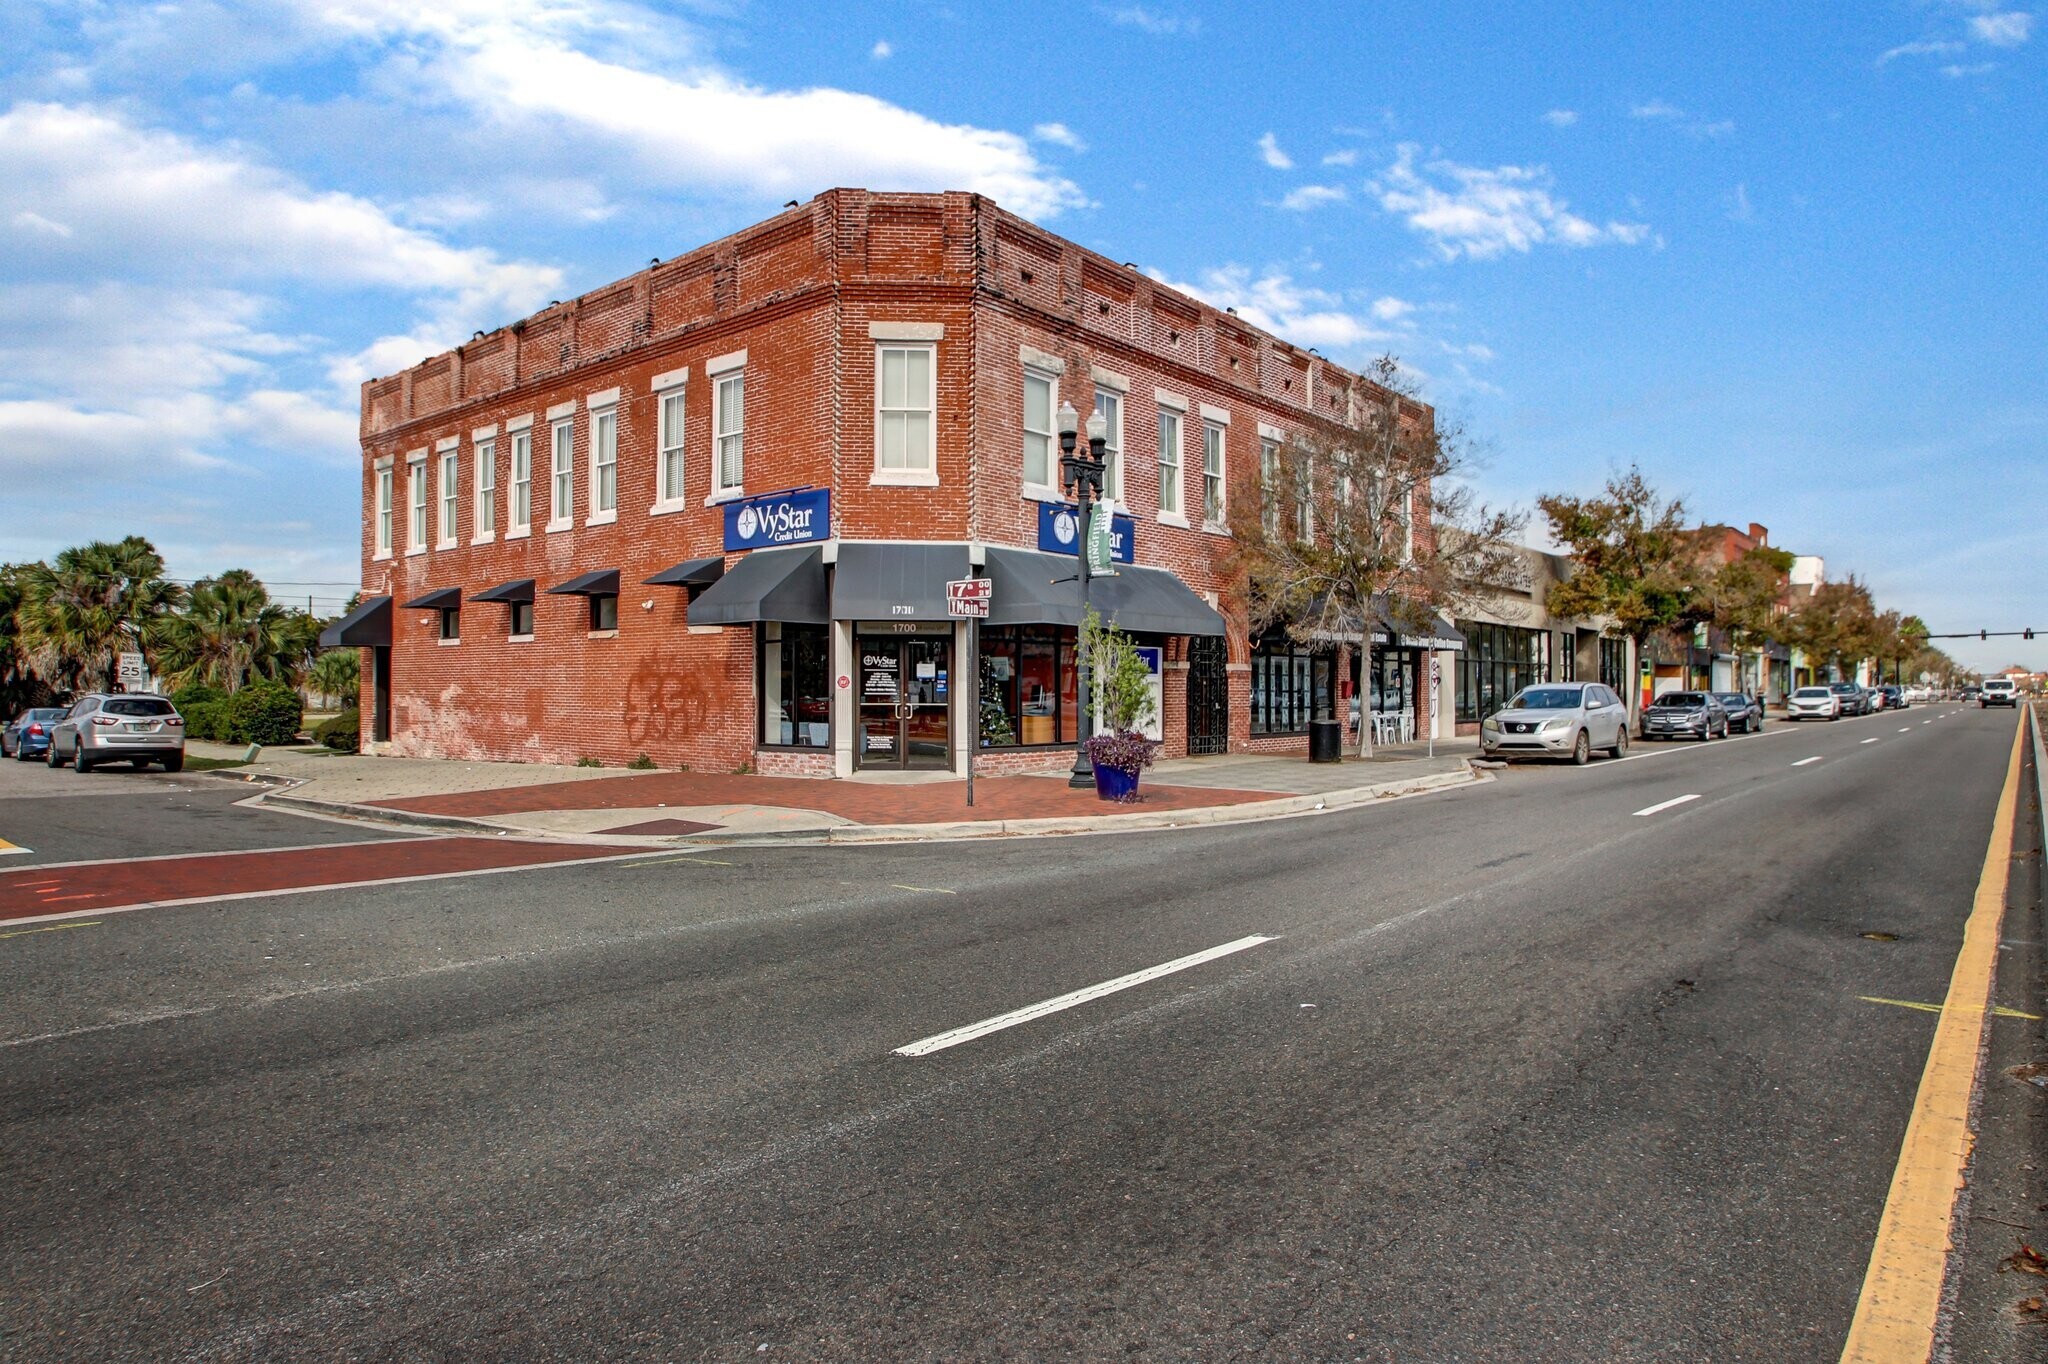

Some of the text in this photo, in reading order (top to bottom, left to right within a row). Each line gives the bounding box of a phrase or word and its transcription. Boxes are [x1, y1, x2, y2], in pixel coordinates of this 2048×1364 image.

[756, 503, 813, 539] VyStar
[774, 529, 812, 542] Credit Union
[1091, 513, 1103, 571] PRINGFIELD
[892, 605, 914, 615] 1700
[956, 600, 979, 615] Main
[892, 623, 917, 633] 1700
[872, 655, 898, 667] VyStar
[121, 666, 140, 676] 25
